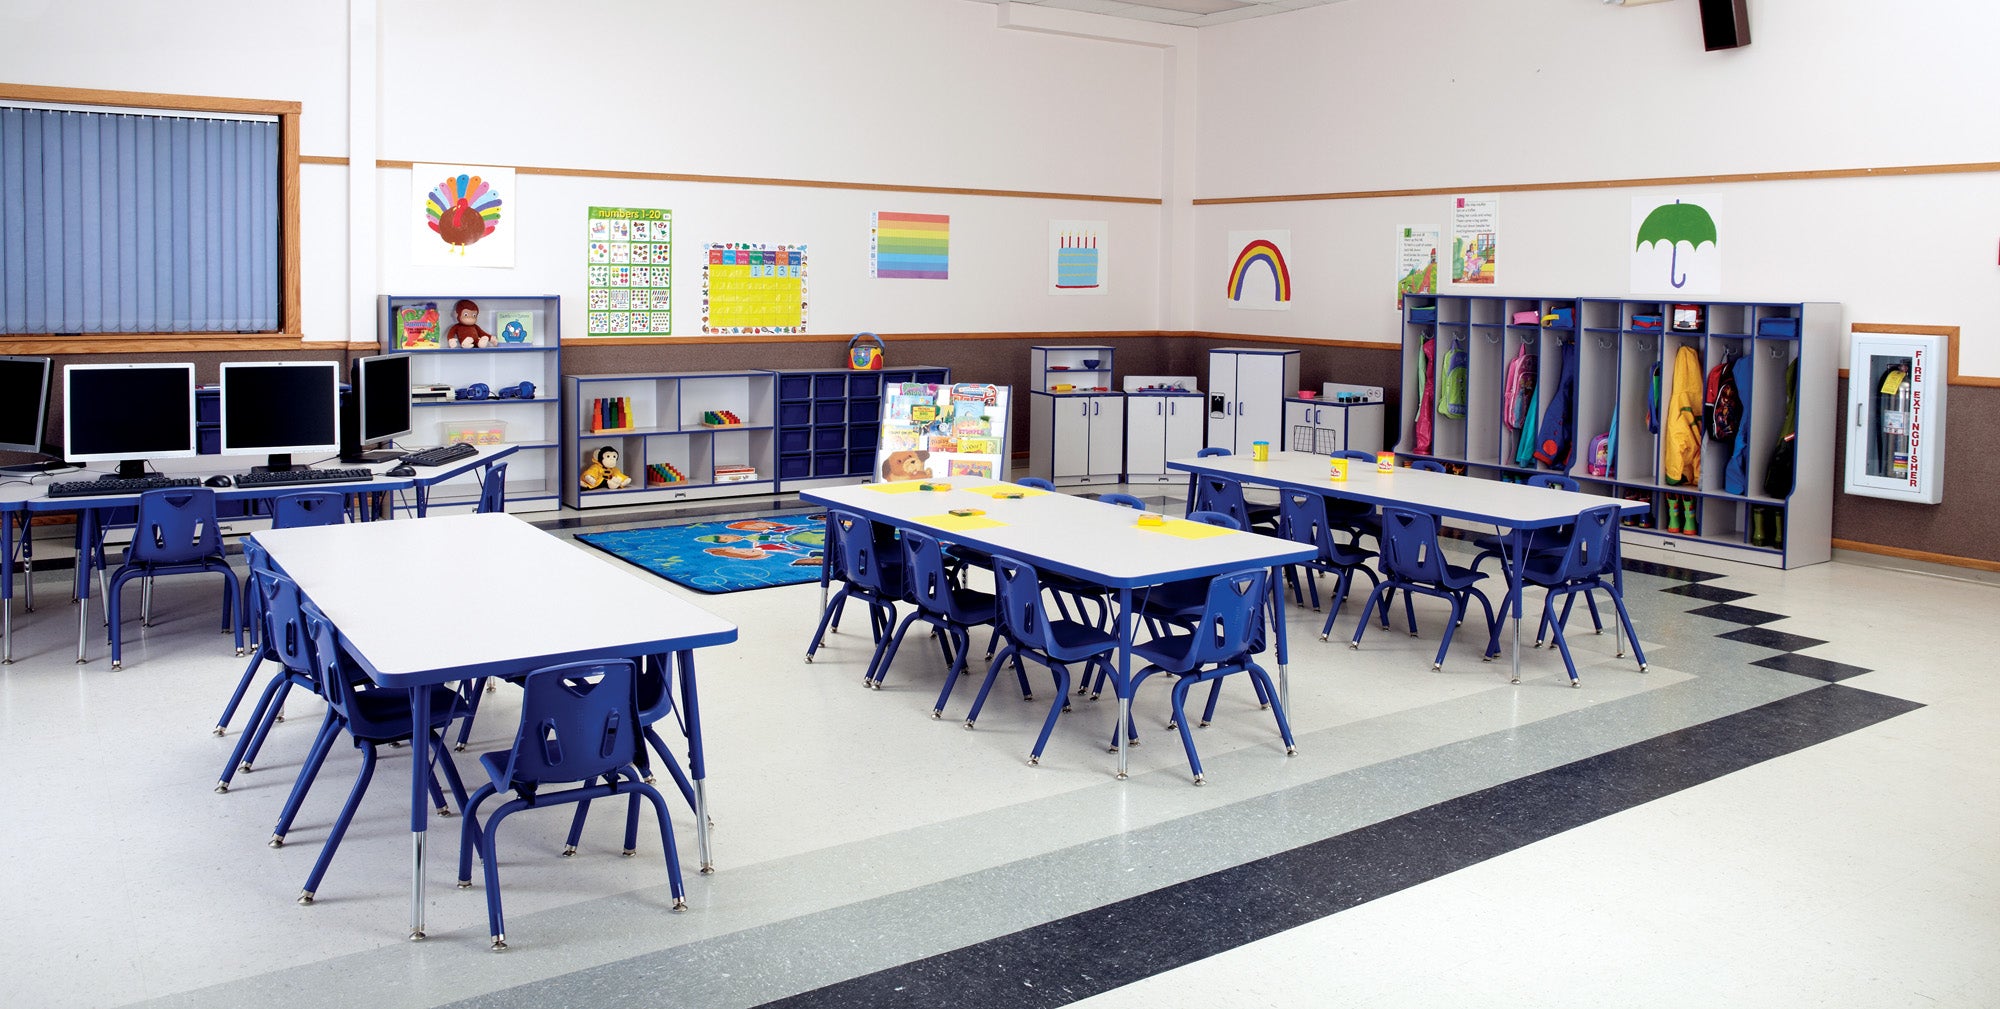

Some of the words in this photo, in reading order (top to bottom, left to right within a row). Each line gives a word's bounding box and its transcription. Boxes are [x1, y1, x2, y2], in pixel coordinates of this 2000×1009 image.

[599, 208, 639, 218] numbers
[641, 209, 661, 219] 1-20
[753, 266, 758, 277] 1
[765, 265, 772, 276] 2
[779, 265, 786, 276] 3
[791, 266, 798, 277] 4
[1910, 391, 1921, 487] EXTINGUISHER
